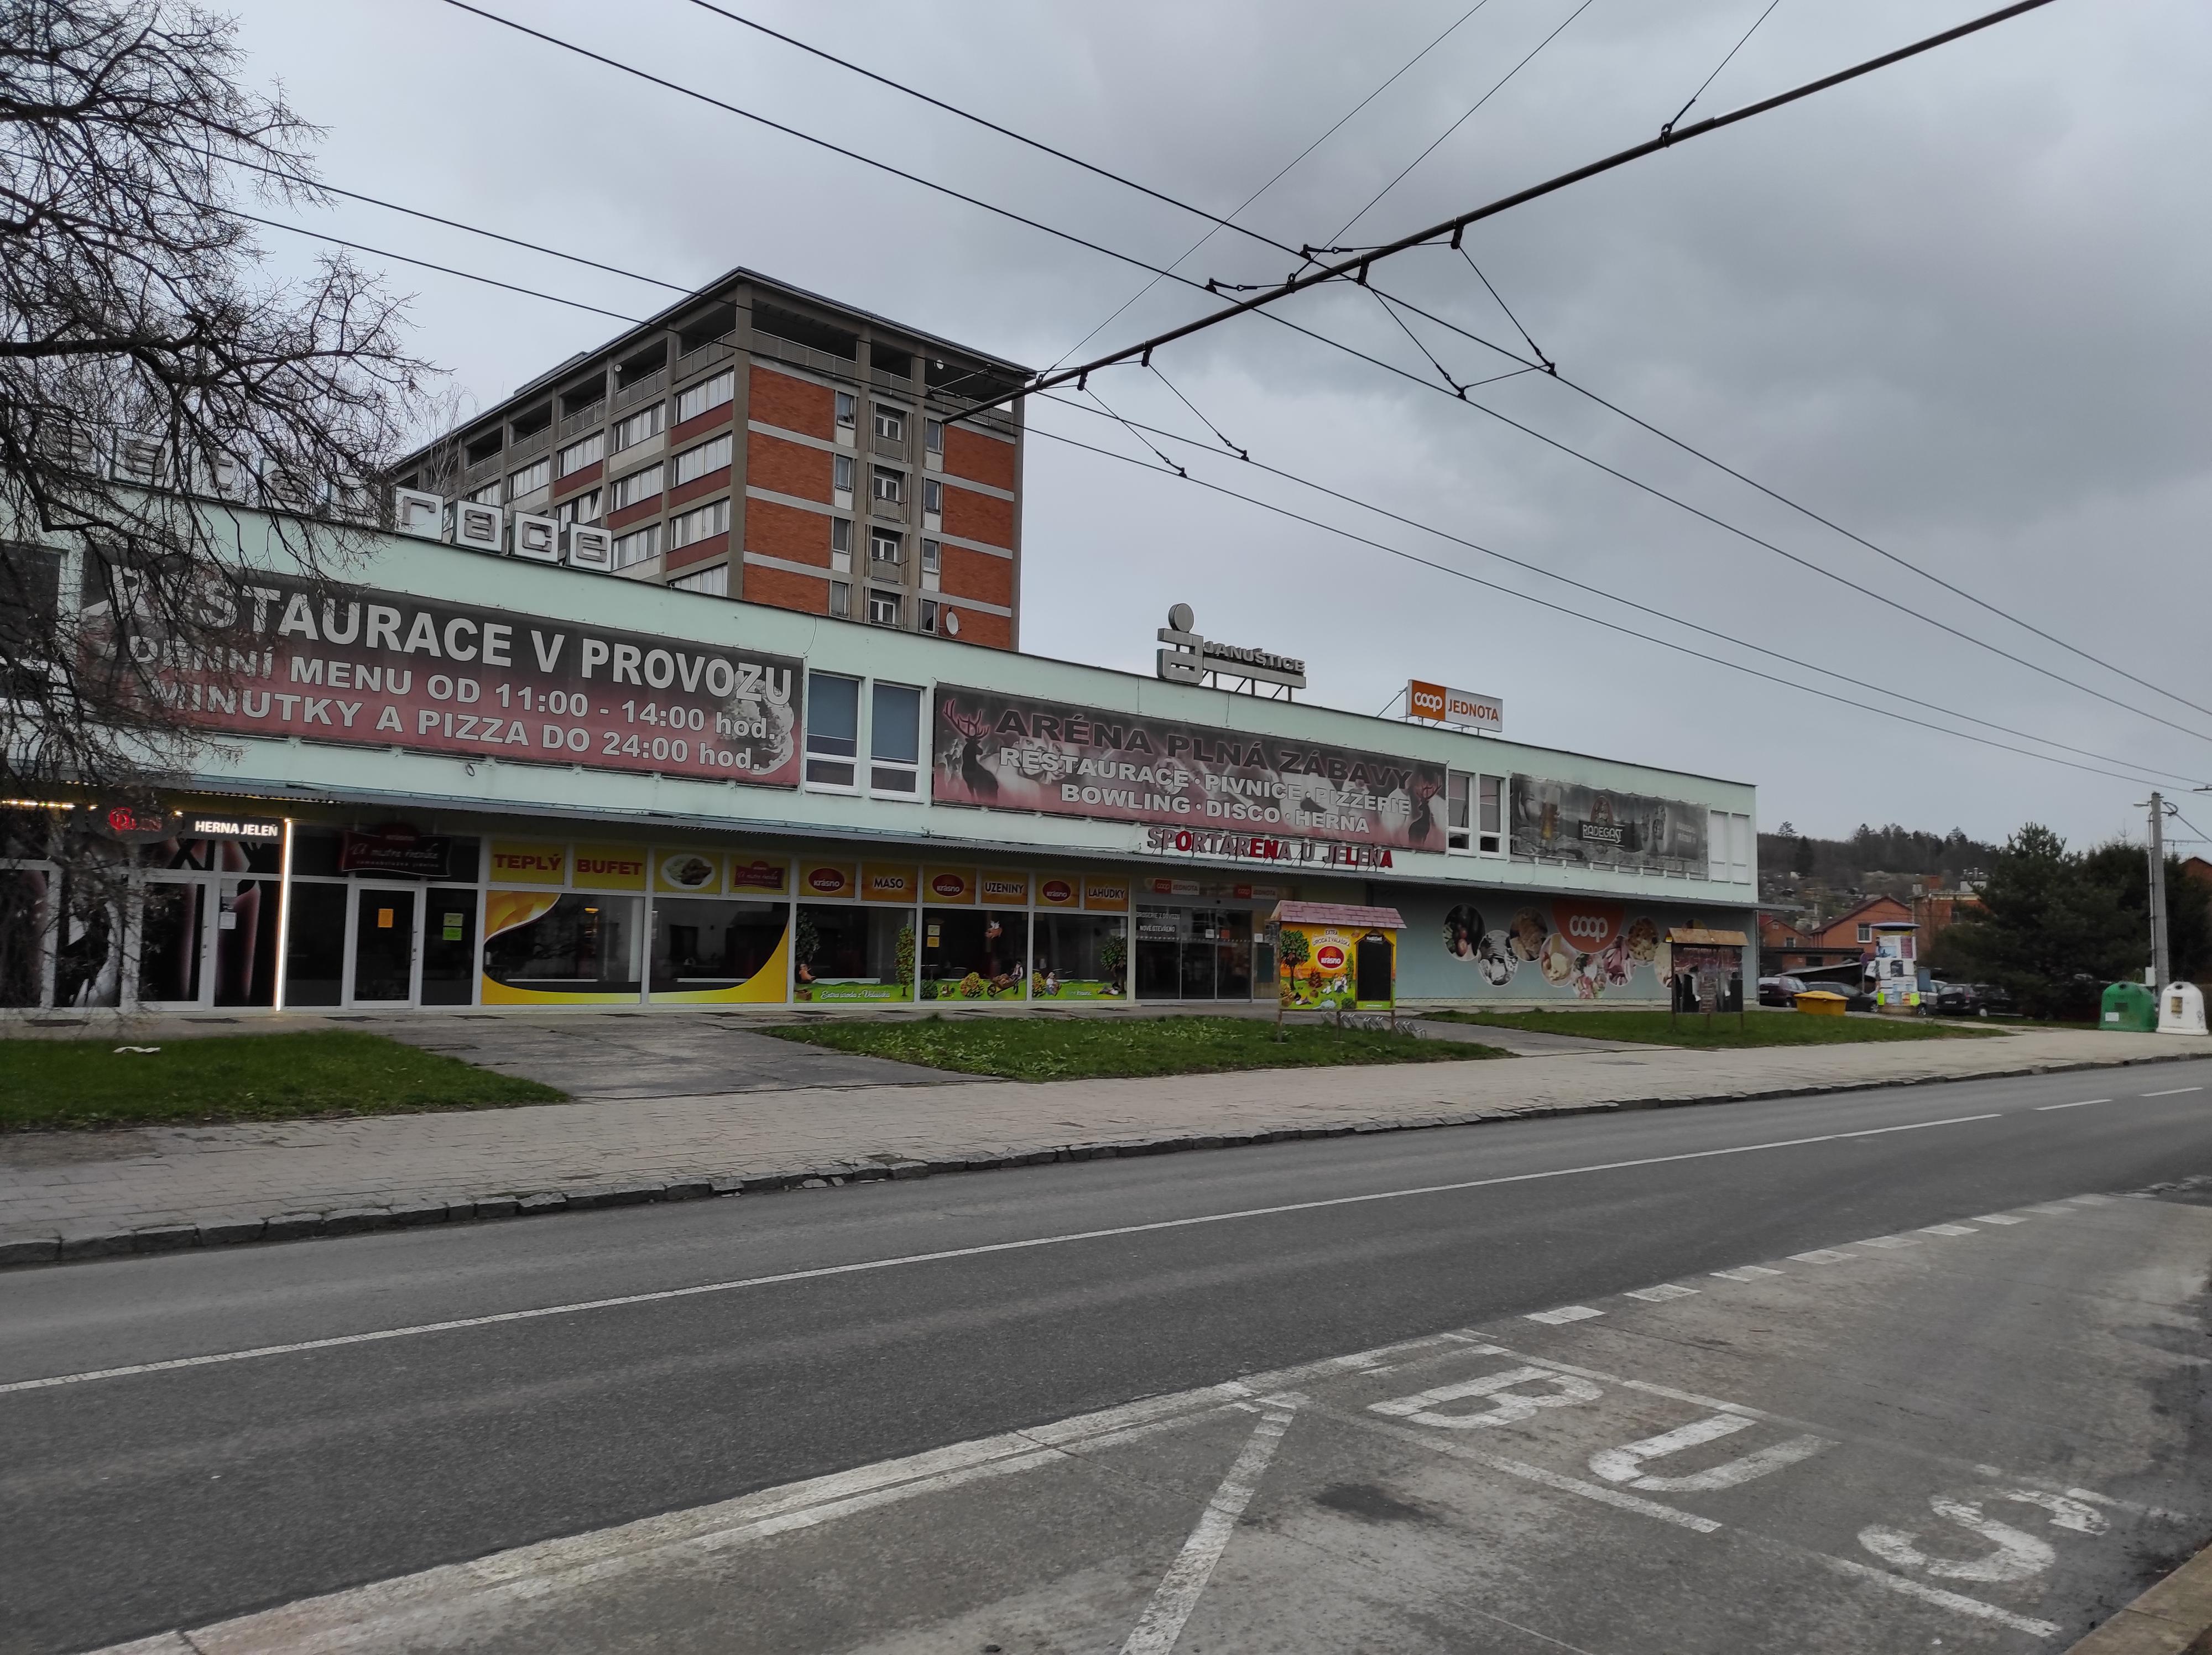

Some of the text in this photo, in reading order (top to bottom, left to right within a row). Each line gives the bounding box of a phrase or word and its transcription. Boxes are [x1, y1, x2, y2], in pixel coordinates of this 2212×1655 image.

[530, 630, 565, 673] V
[581, 638, 792, 706] PROVOZU
[1203, 641, 1306, 673] JANUŠTICE
[290, 657, 412, 696] MENU
[427, 674, 481, 703] OD
[495, 683, 588, 717] 11:00
[621, 701, 705, 732] 14:00
[715, 711, 775, 740] hod.
[1414, 691, 1499, 722] coop JEDNOTA
[375, 706, 403, 733] A
[418, 710, 529, 746] PIZZA
[542, 724, 590, 751] DO
[602, 732, 688, 763] 24:00
[699, 742, 760, 770] hod.
[995, 709, 1413, 789] ARÉNA PLNÁ ZÁBAVY
[1000, 746, 1410, 815] RESTAURACE PIVNICE PIZZERIE
[1061, 783, 1370, 834] BOWLING DISCO HERNA
[195, 821, 239, 834] HERNA
[1582, 824, 1624, 844] RADEGAST
[1146, 827, 1393, 868] SPORTARENA U JELENA
[494, 853, 643, 875] TEPLÝ BUFET
[874, 877, 904, 889] MASO
[985, 882, 1024, 894] UZENINY
[1172, 884, 1198, 892] JEDNOTA
[1569, 915, 1608, 943] coop
[1367, 1363, 2111, 1583] BUS
